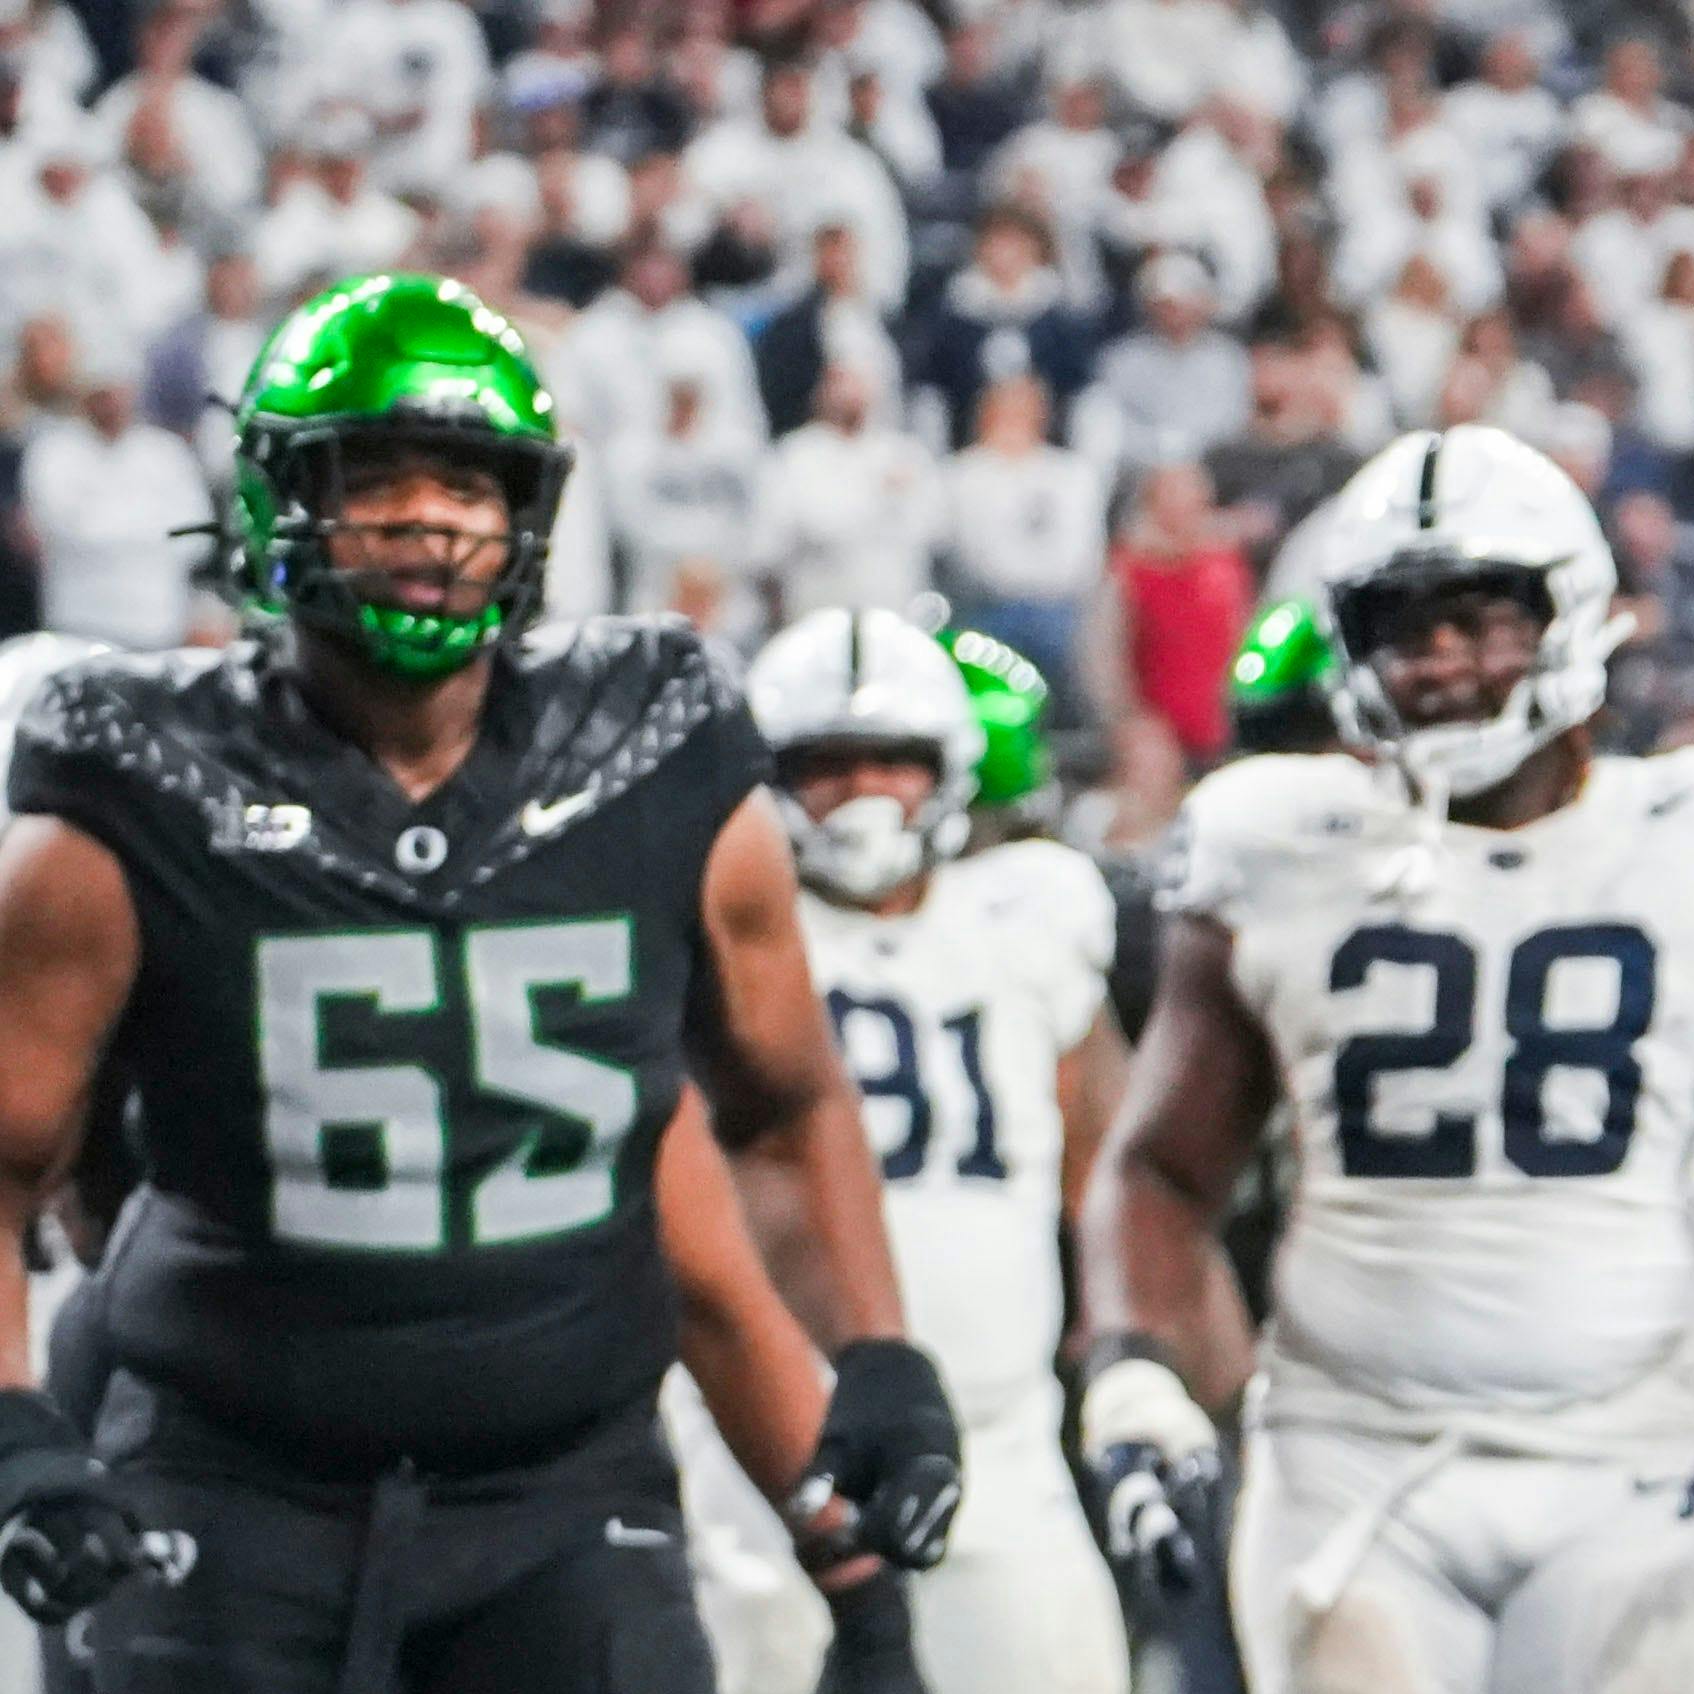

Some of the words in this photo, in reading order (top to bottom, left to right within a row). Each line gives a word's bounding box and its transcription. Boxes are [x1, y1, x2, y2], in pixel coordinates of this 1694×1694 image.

[394, 826, 449, 875] O
[252, 907, 639, 1254] 65
[1328, 921, 1660, 1180] 28
